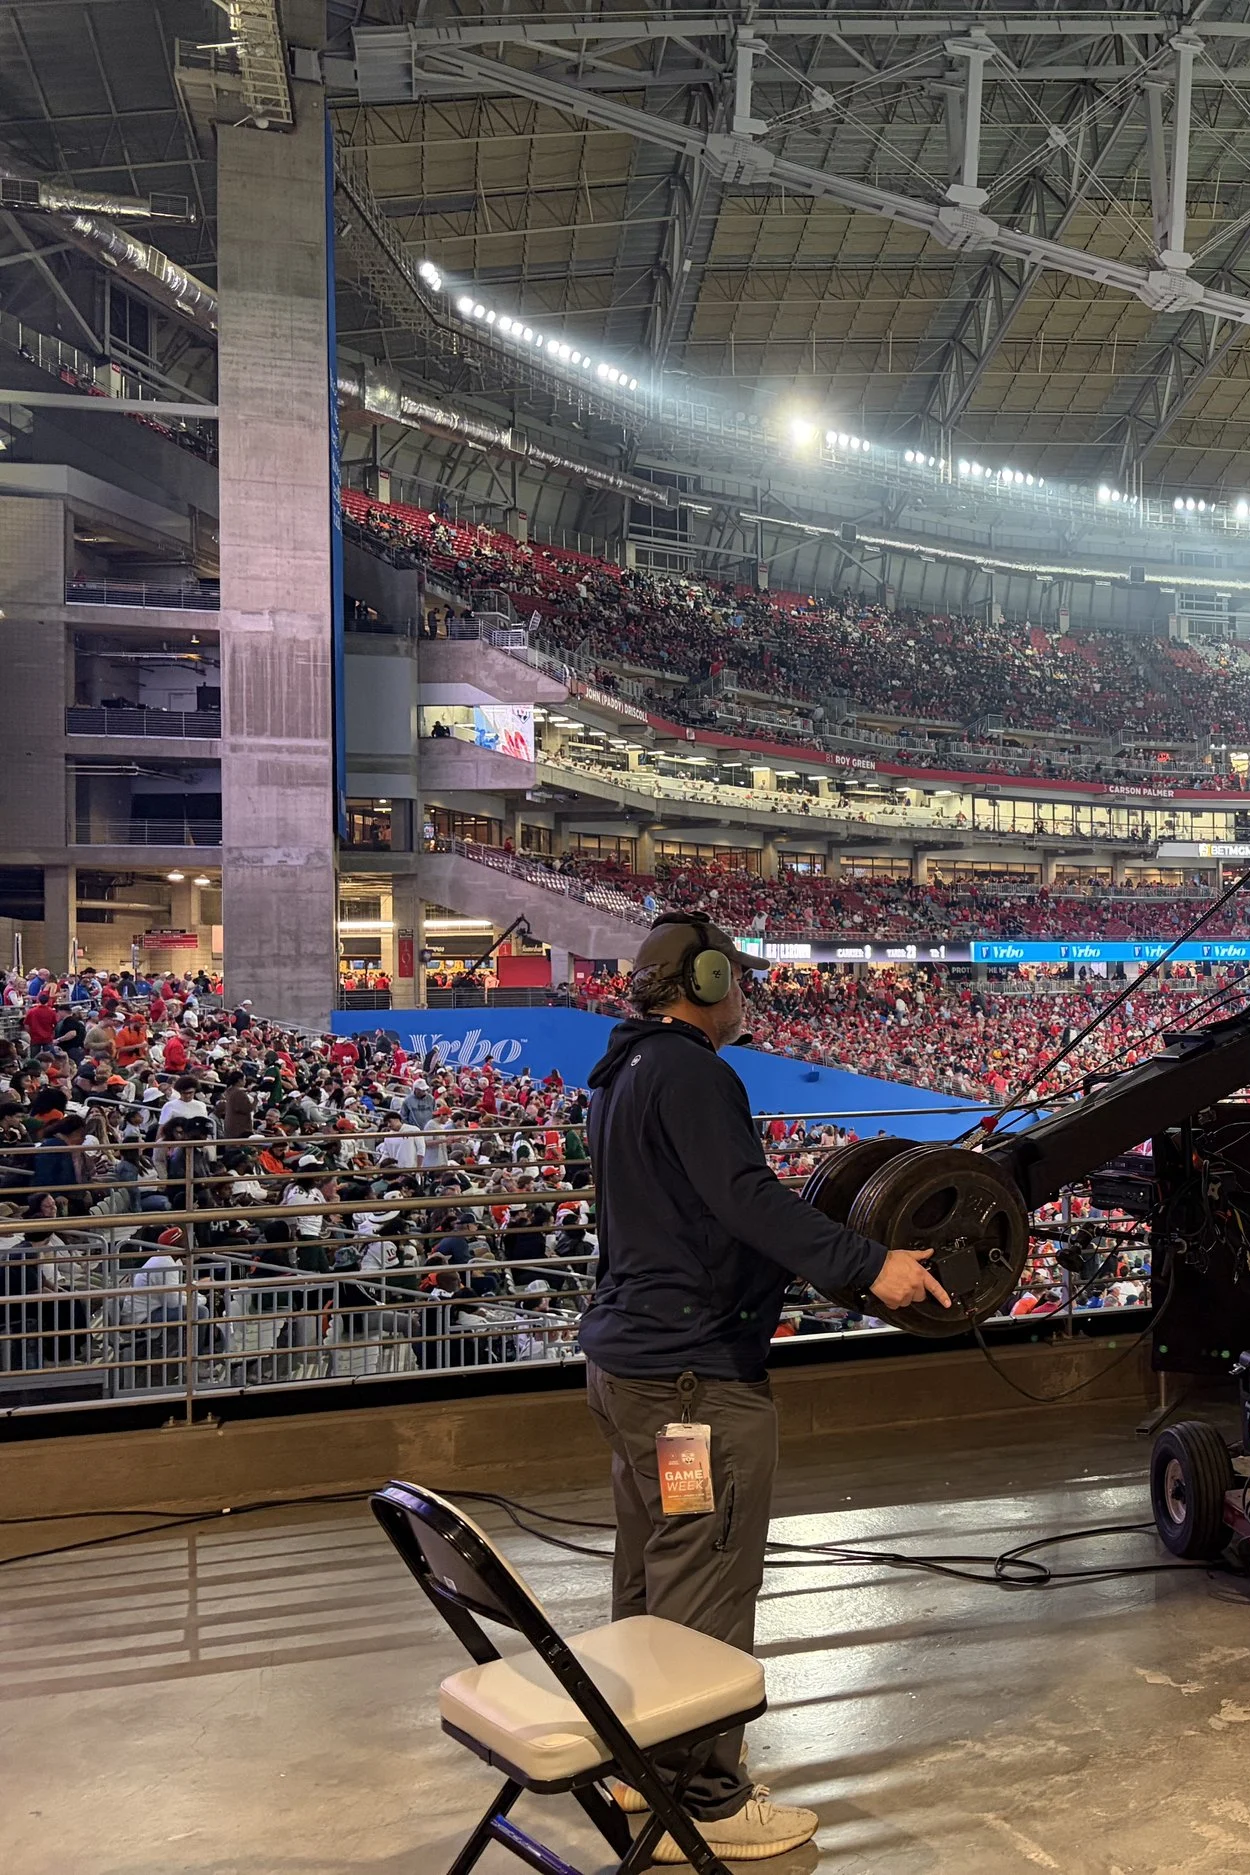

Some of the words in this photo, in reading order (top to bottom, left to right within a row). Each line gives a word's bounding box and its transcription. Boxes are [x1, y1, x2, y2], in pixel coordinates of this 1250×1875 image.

[585, 687, 601, 703] JOHN
[601, 694, 624, 714] (PADDY)
[624, 703, 649, 723] DRISCOLL
[835, 755, 850, 765] ROY
[852, 758, 876, 770] GREEN
[1109, 786, 1141, 796] CARSON
[1142, 789, 1174, 798] PALMER
[992, 945, 1024, 958] Vrbo
[1072, 945, 1100, 958] Vrbo
[1213, 944, 1247, 957] Vrbo
[664, 1469, 704, 1481] GAME
[667, 1479, 704, 1492] WEEK
